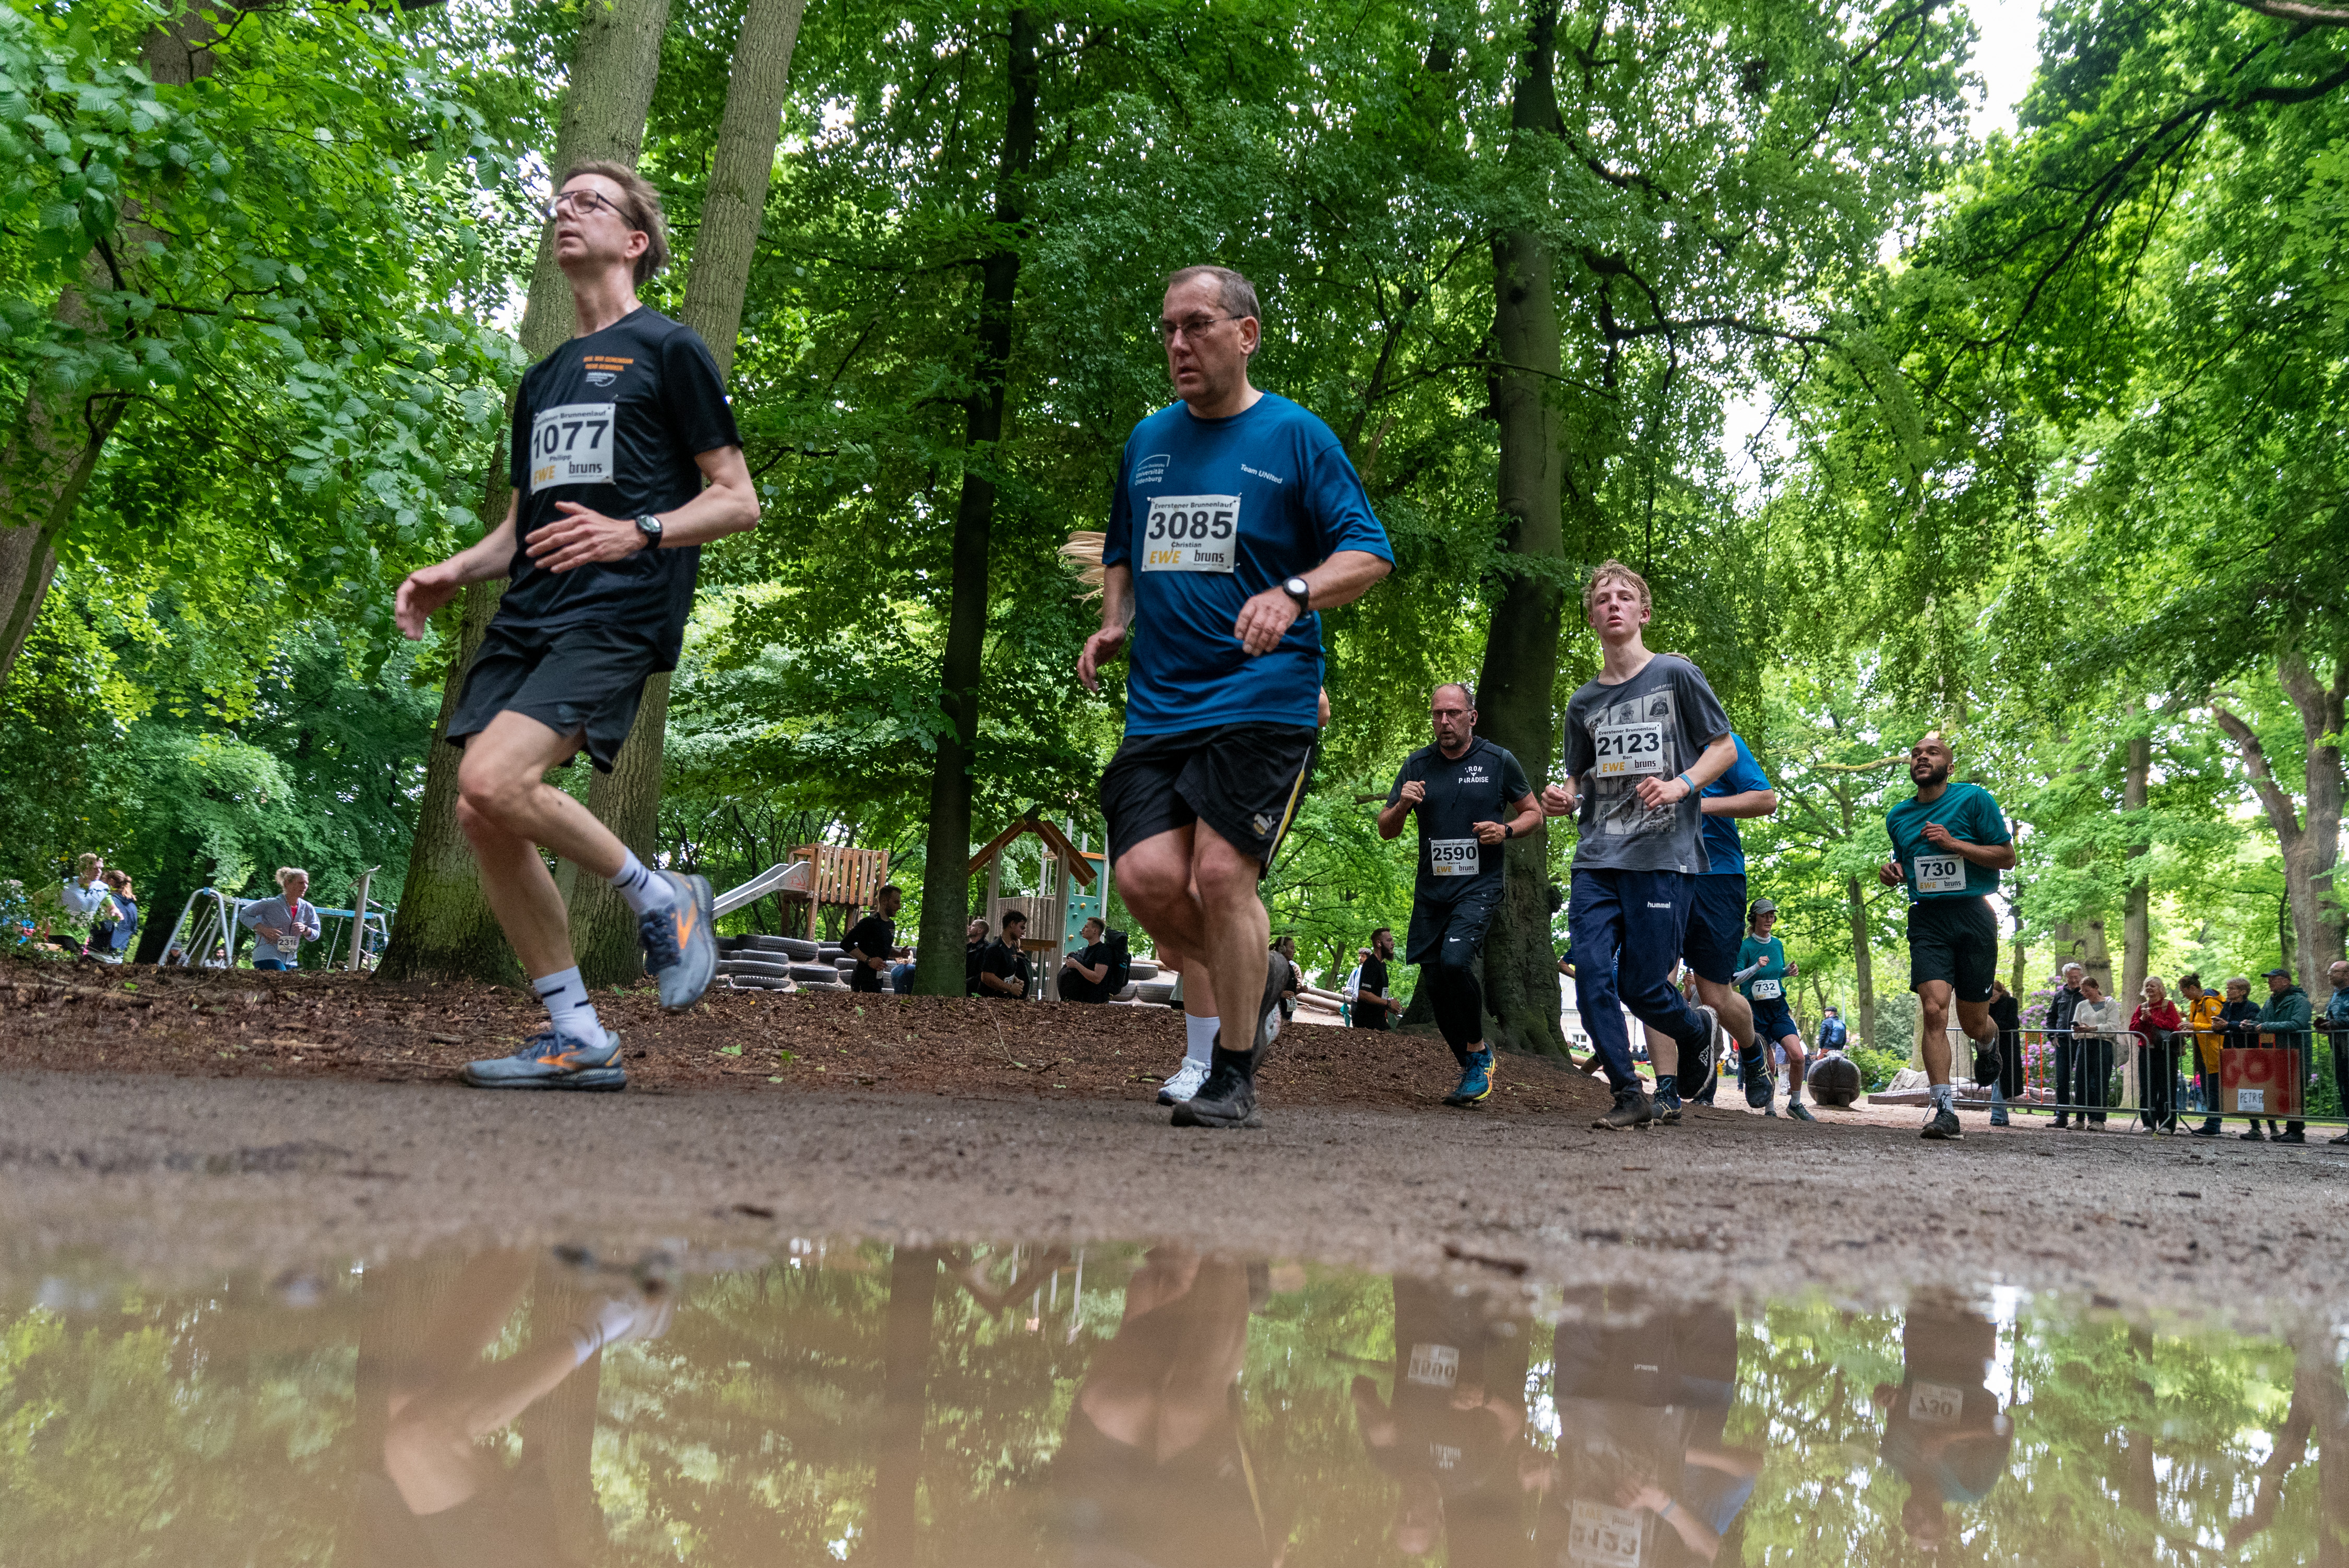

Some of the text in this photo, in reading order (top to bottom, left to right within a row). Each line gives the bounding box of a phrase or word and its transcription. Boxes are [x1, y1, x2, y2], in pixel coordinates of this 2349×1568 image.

[561, 410, 606, 419] Brunnenlauf
[534, 420, 609, 459] 1077
[533, 461, 602, 485] EWE bruns
[1241, 464, 1258, 476] Team
[1135, 476, 1162, 486] Oldenburg
[1148, 511, 1233, 540] 3085
[1149, 549, 1224, 564] EWE bruns
[1597, 732, 1659, 756] 2123
[1603, 759, 1656, 773] EWE bruns
[1432, 846, 1477, 861] 2590
[1920, 861, 1956, 877] 730
[1755, 982, 1776, 992] 732
